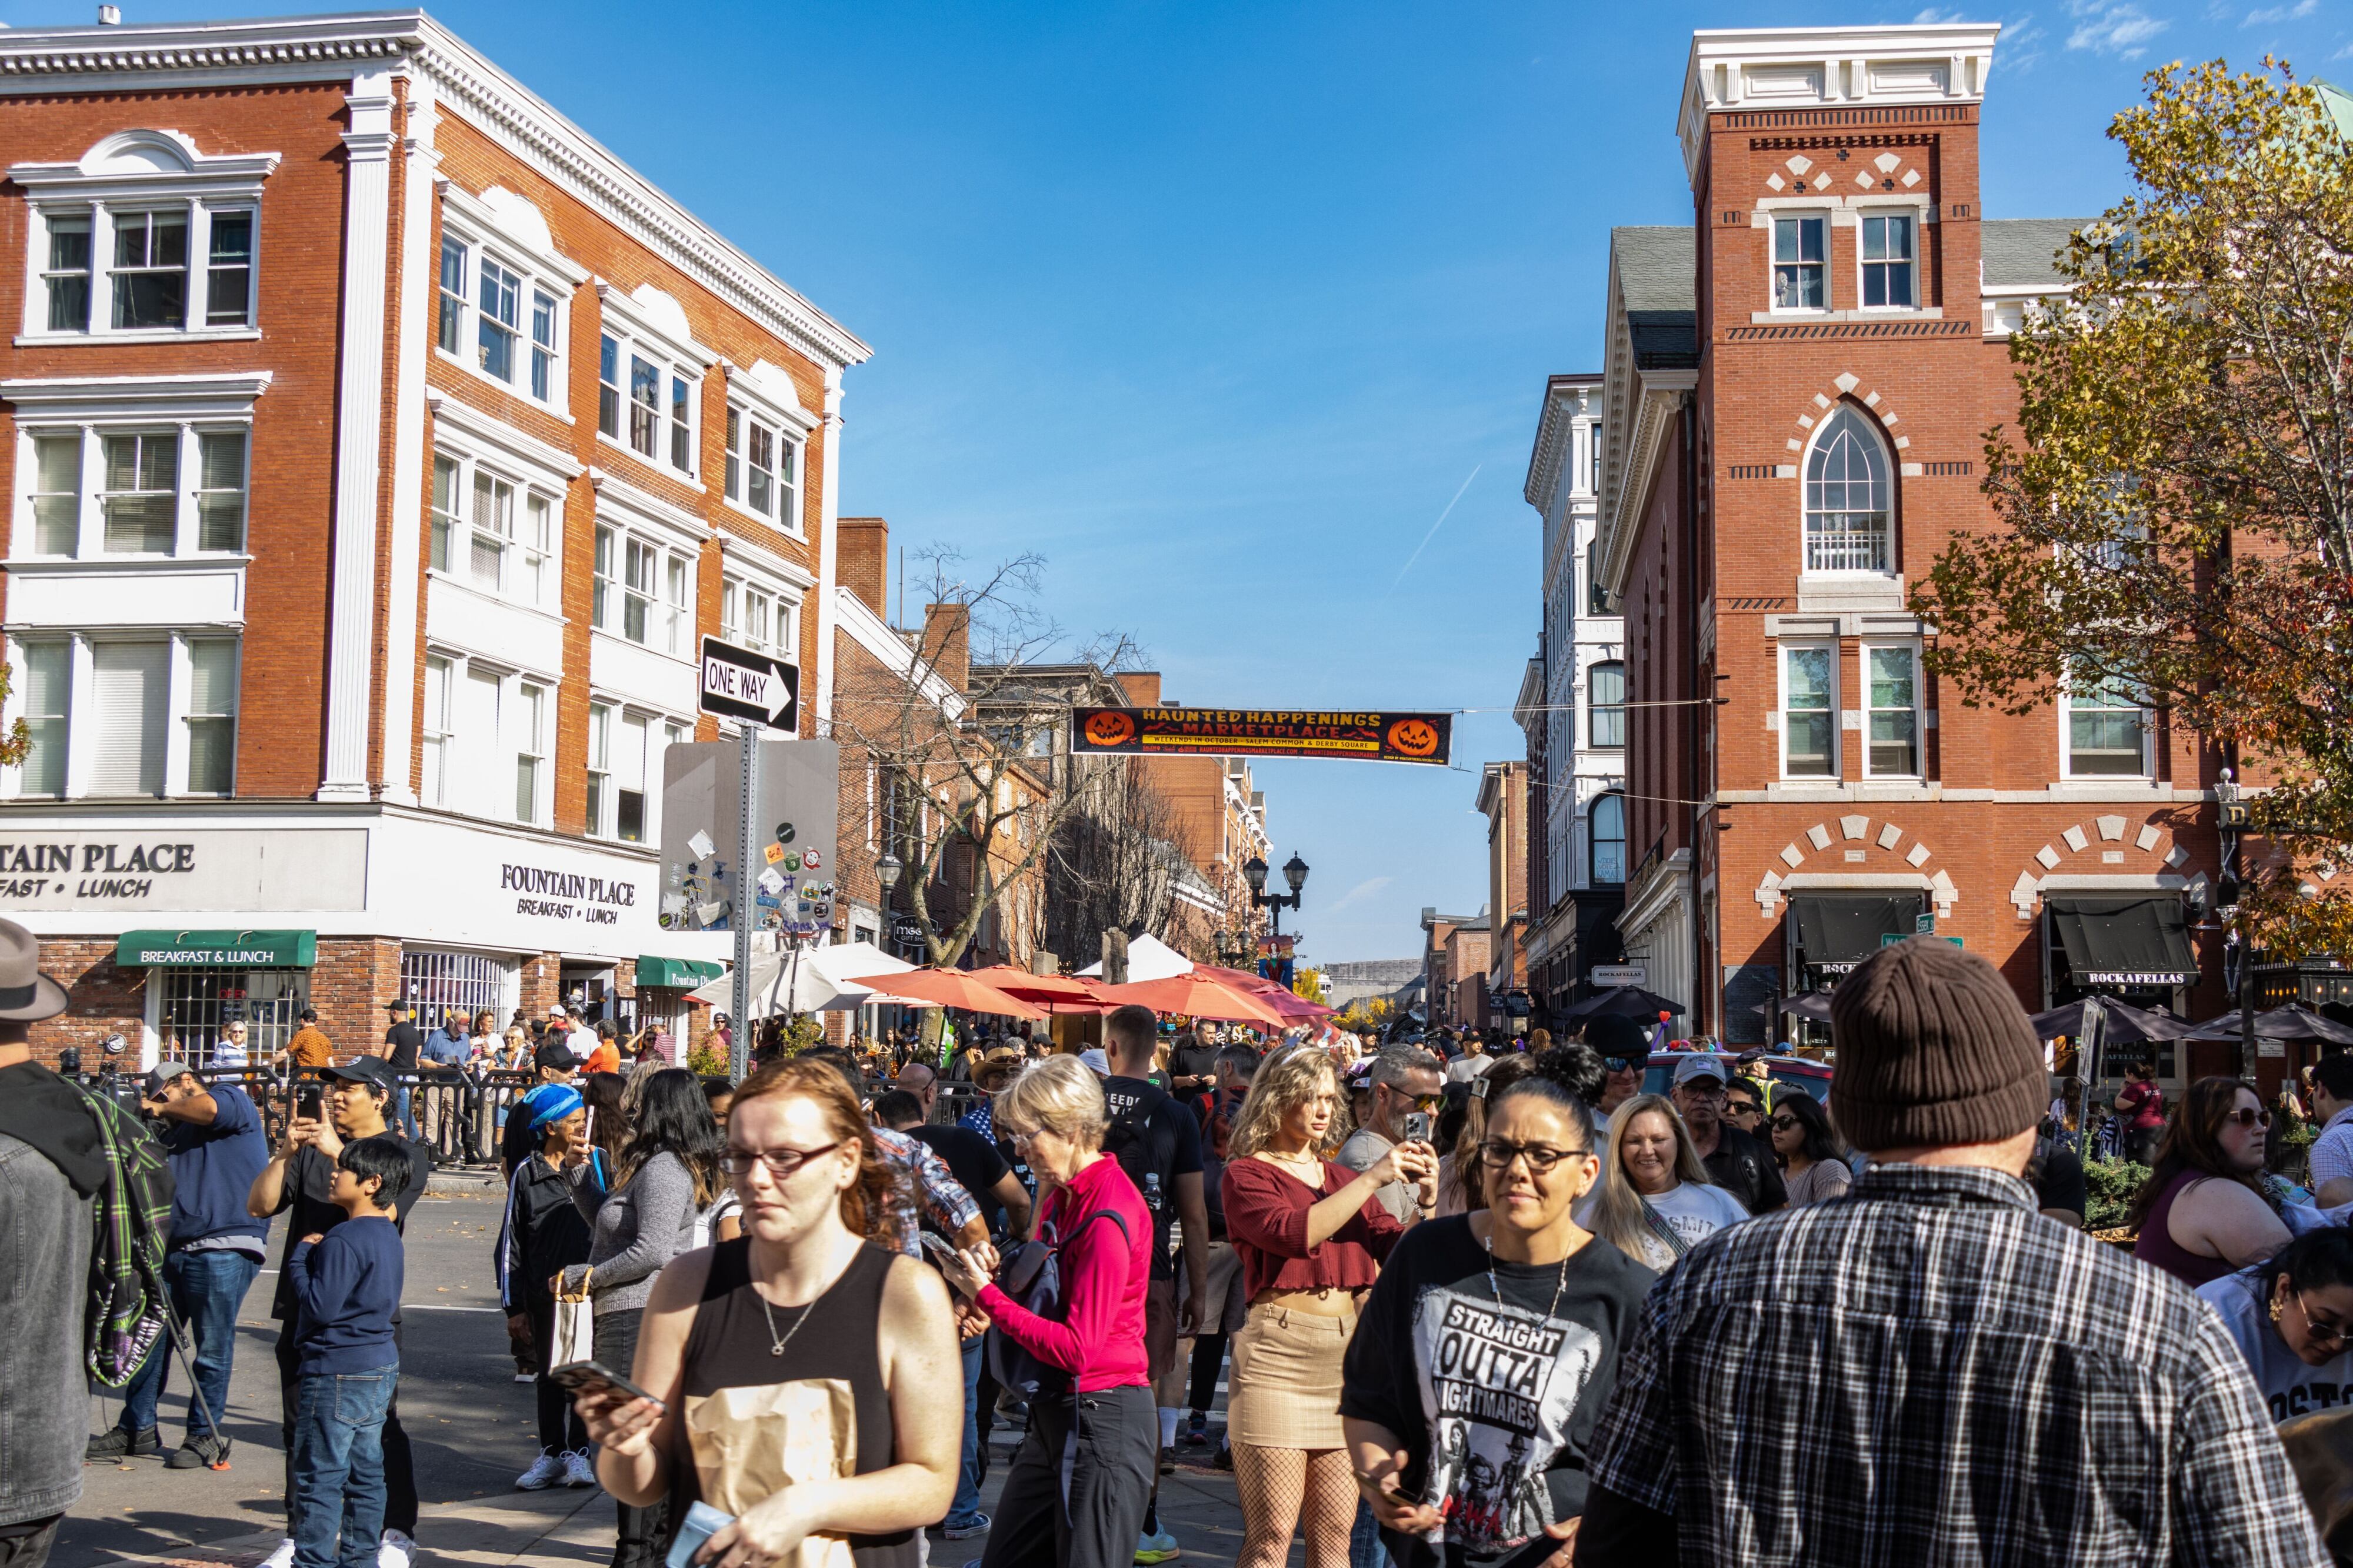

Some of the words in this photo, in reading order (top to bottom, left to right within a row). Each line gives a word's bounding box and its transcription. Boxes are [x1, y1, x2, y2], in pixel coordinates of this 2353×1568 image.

[709, 662, 735, 695] ONE
[741, 672, 767, 703] WAY
[1143, 709, 1242, 723] HAUNTED
[1247, 712, 1381, 727] HAPPENINGS
[1182, 723, 1341, 739] MARKETPLACE
[81, 844, 195, 873] PLACE
[76, 879, 152, 898] LUNCH
[501, 863, 586, 899] FOUNTAIN
[588, 878, 635, 907] PLACE
[517, 898, 574, 919] BREAKFAST
[586, 908, 618, 925] LUNCH
[141, 951, 209, 963] BREAKFAST
[214, 951, 224, 963] &
[227, 951, 274, 963] LUNCH
[671, 973, 699, 987] Fountain
[2089, 973, 2184, 984] ROCKAFELLAS
[1015, 1164, 1028, 1173] UP
[1669, 1216, 1716, 1236] SMIT
[1448, 1303, 1561, 1354] STRAIGHT
[1439, 1332, 1542, 1397] OUTTA
